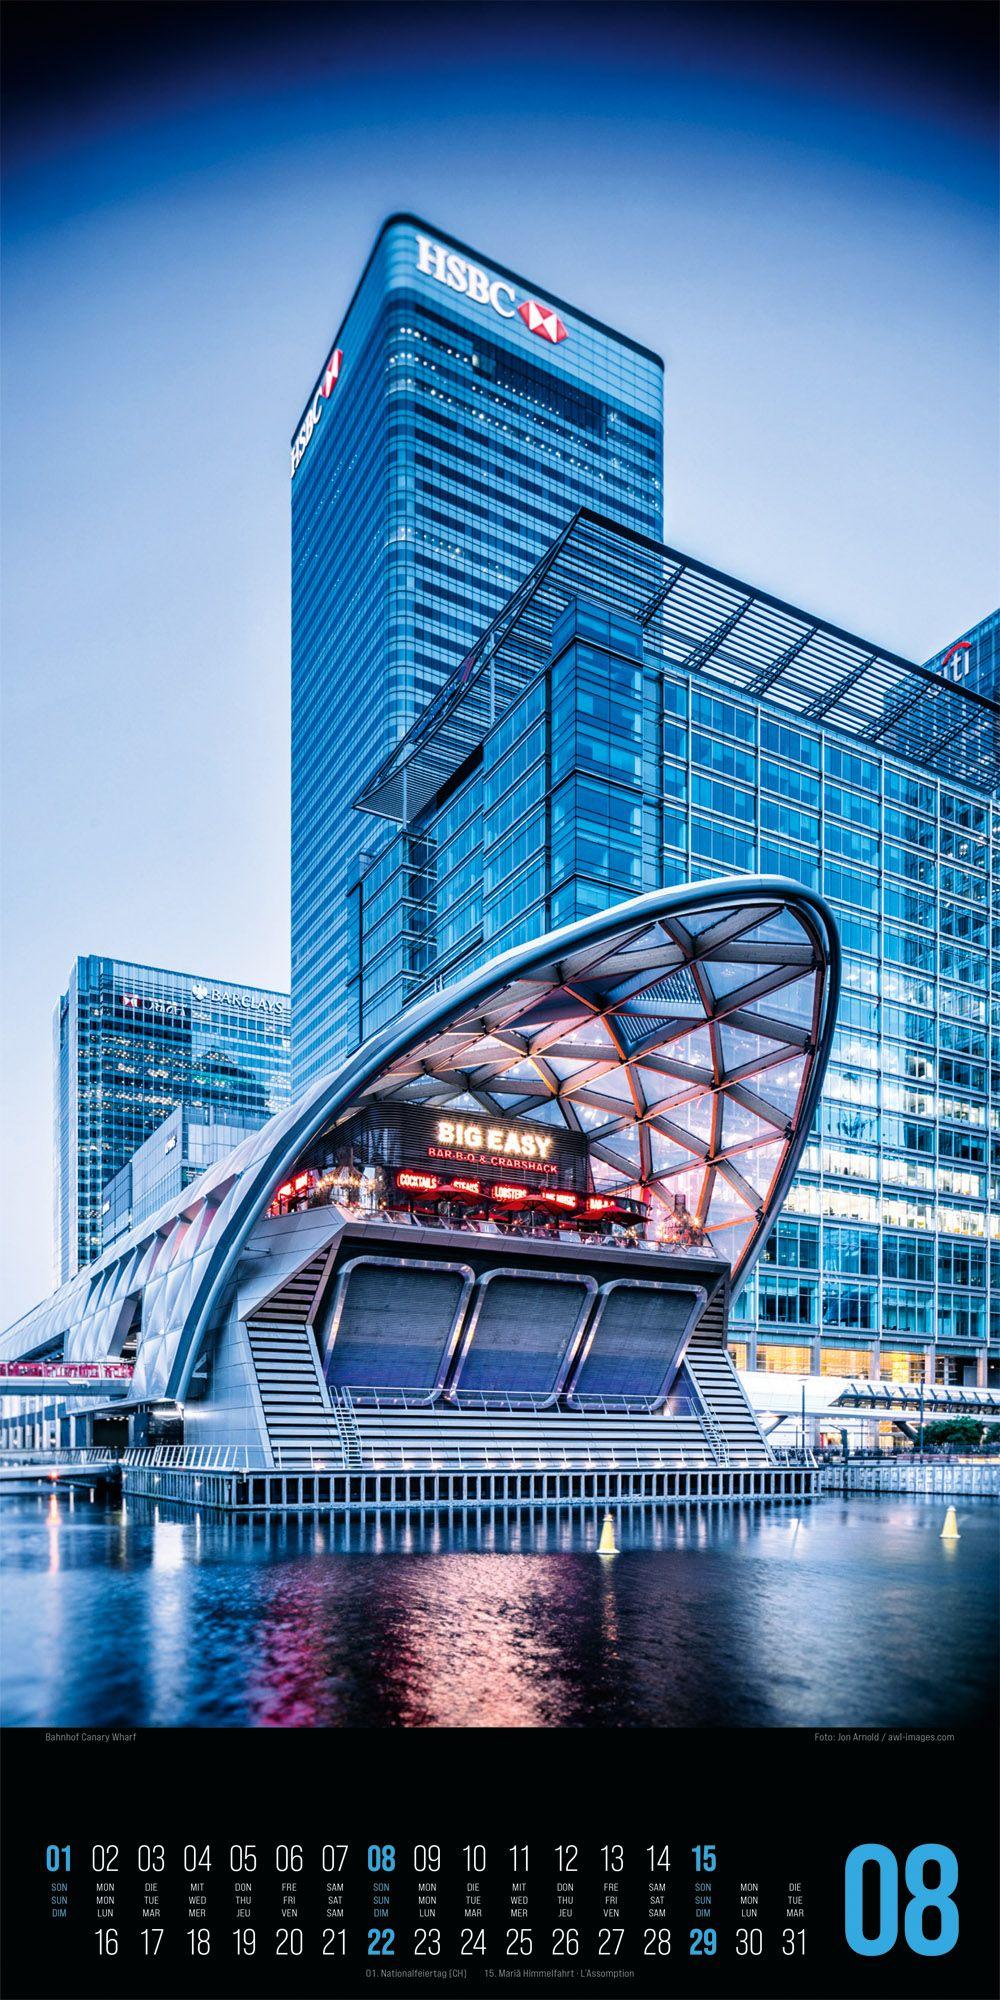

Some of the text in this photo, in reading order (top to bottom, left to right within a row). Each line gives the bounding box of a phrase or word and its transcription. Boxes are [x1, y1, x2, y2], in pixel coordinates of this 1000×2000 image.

[415, 235, 516, 318] HSBC
[291, 386, 322, 479] HSBC
[211, 989, 284, 1014] BARCLAYS
[437, 1120, 552, 1158] BIG EASY
[479, 1155, 487, 1164] &
[490, 1156, 558, 1174] CRABSHACK
[399, 1173, 438, 1189] COCKTAILS
